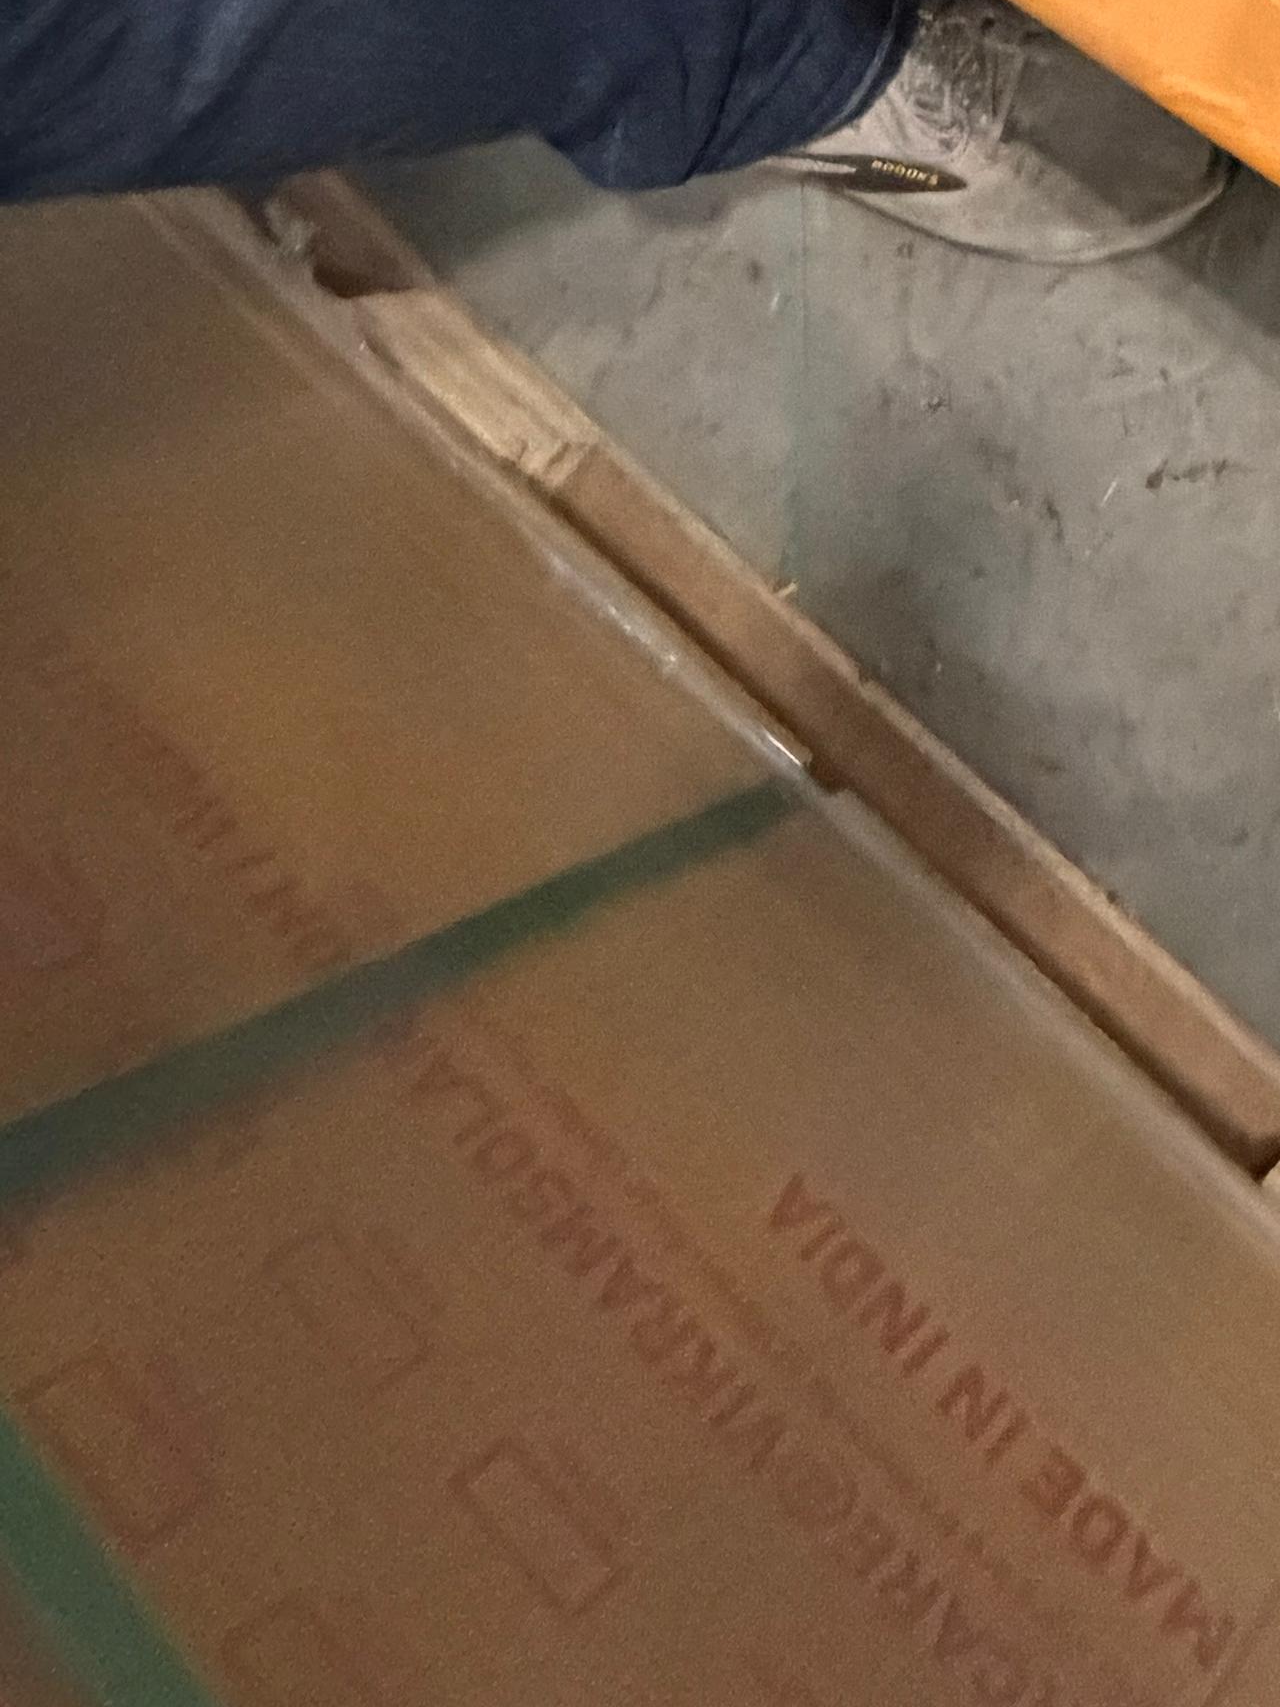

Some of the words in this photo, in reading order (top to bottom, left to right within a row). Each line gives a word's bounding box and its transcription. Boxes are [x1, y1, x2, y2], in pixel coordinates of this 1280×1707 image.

[760, 1172, 952, 1379] INDIA
[935, 1364, 1037, 1469] IN
[1019, 1443, 1237, 1671] MADE
